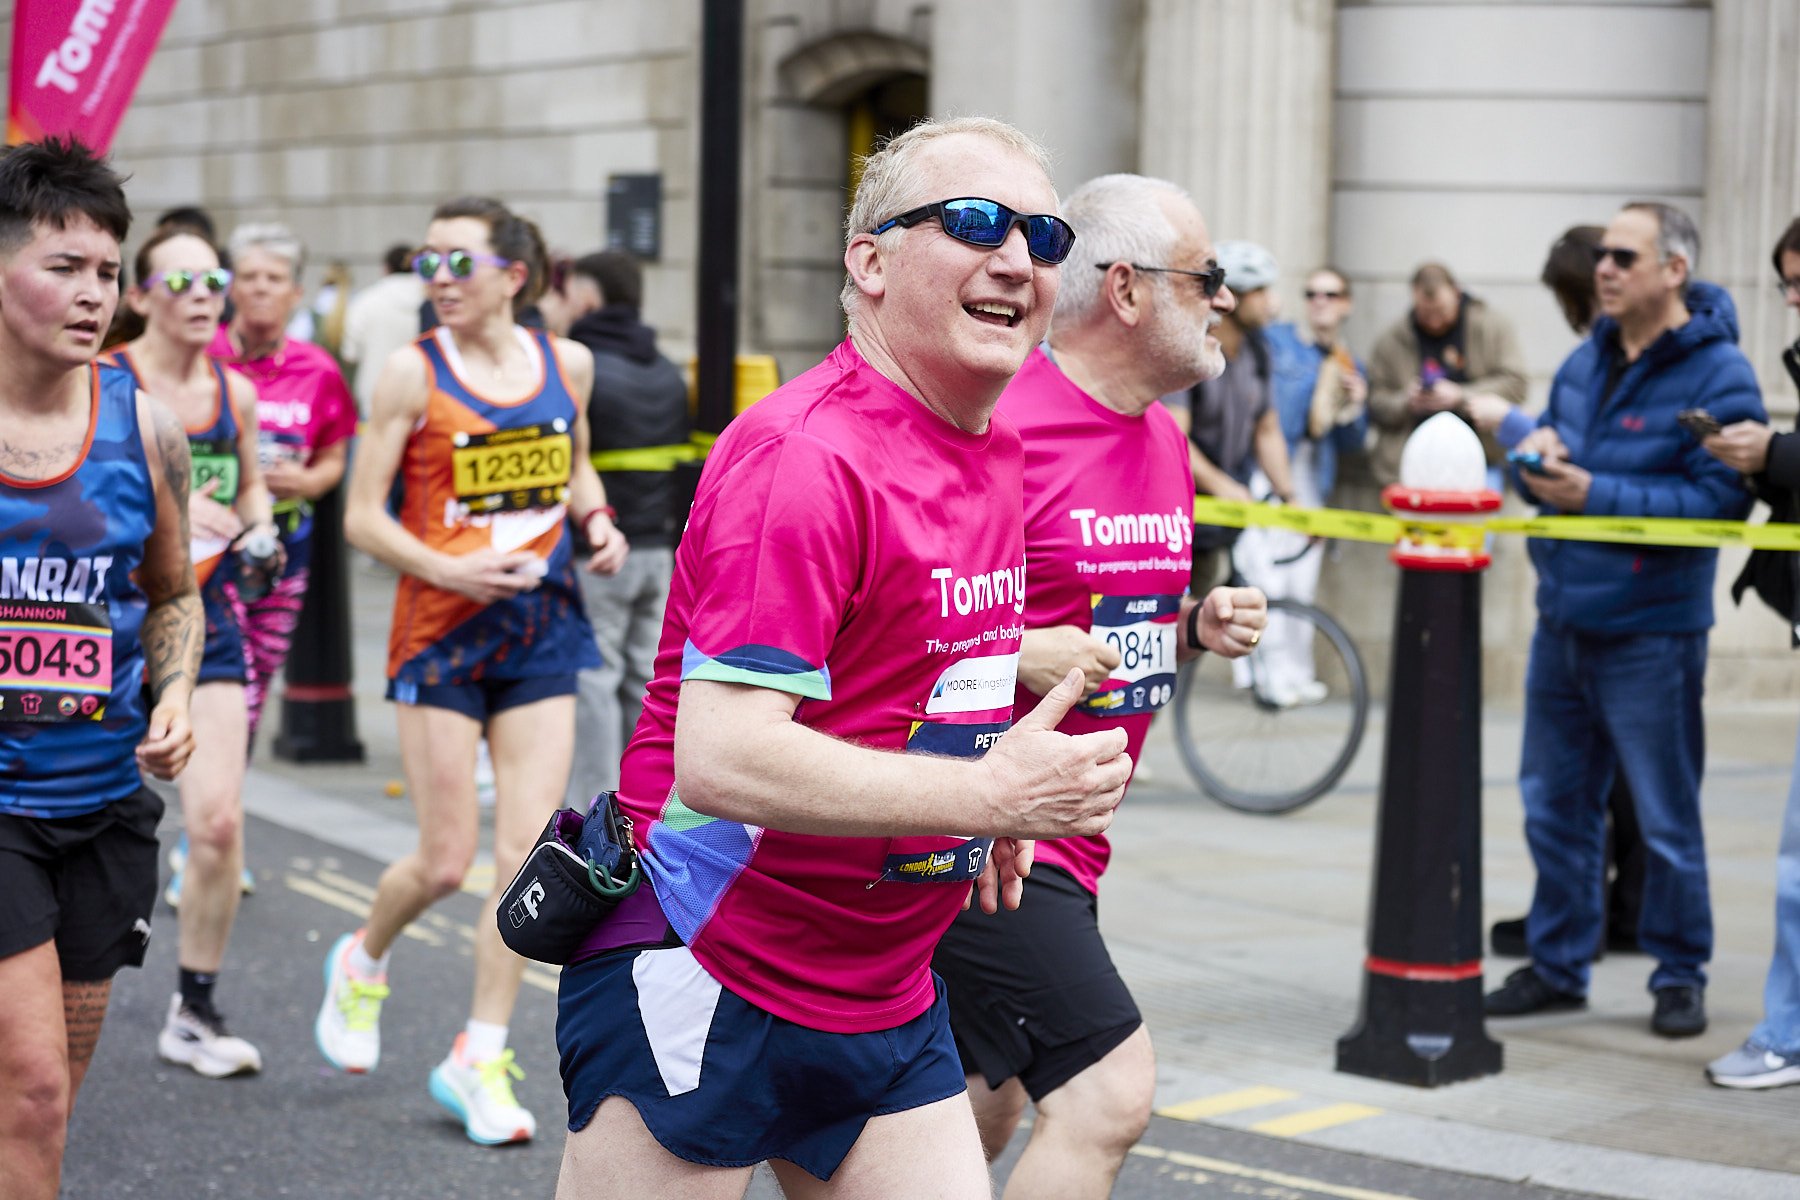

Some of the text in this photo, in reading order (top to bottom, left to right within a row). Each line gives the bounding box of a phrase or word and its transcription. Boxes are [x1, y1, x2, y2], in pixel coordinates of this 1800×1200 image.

[467, 448, 564, 485] 12320
[1070, 506, 1192, 553] Tommy's
[1075, 560, 1097, 573] The
[926, 639, 949, 654] The
[983, 626, 998, 642] and
[945, 679, 977, 691] MOORE
